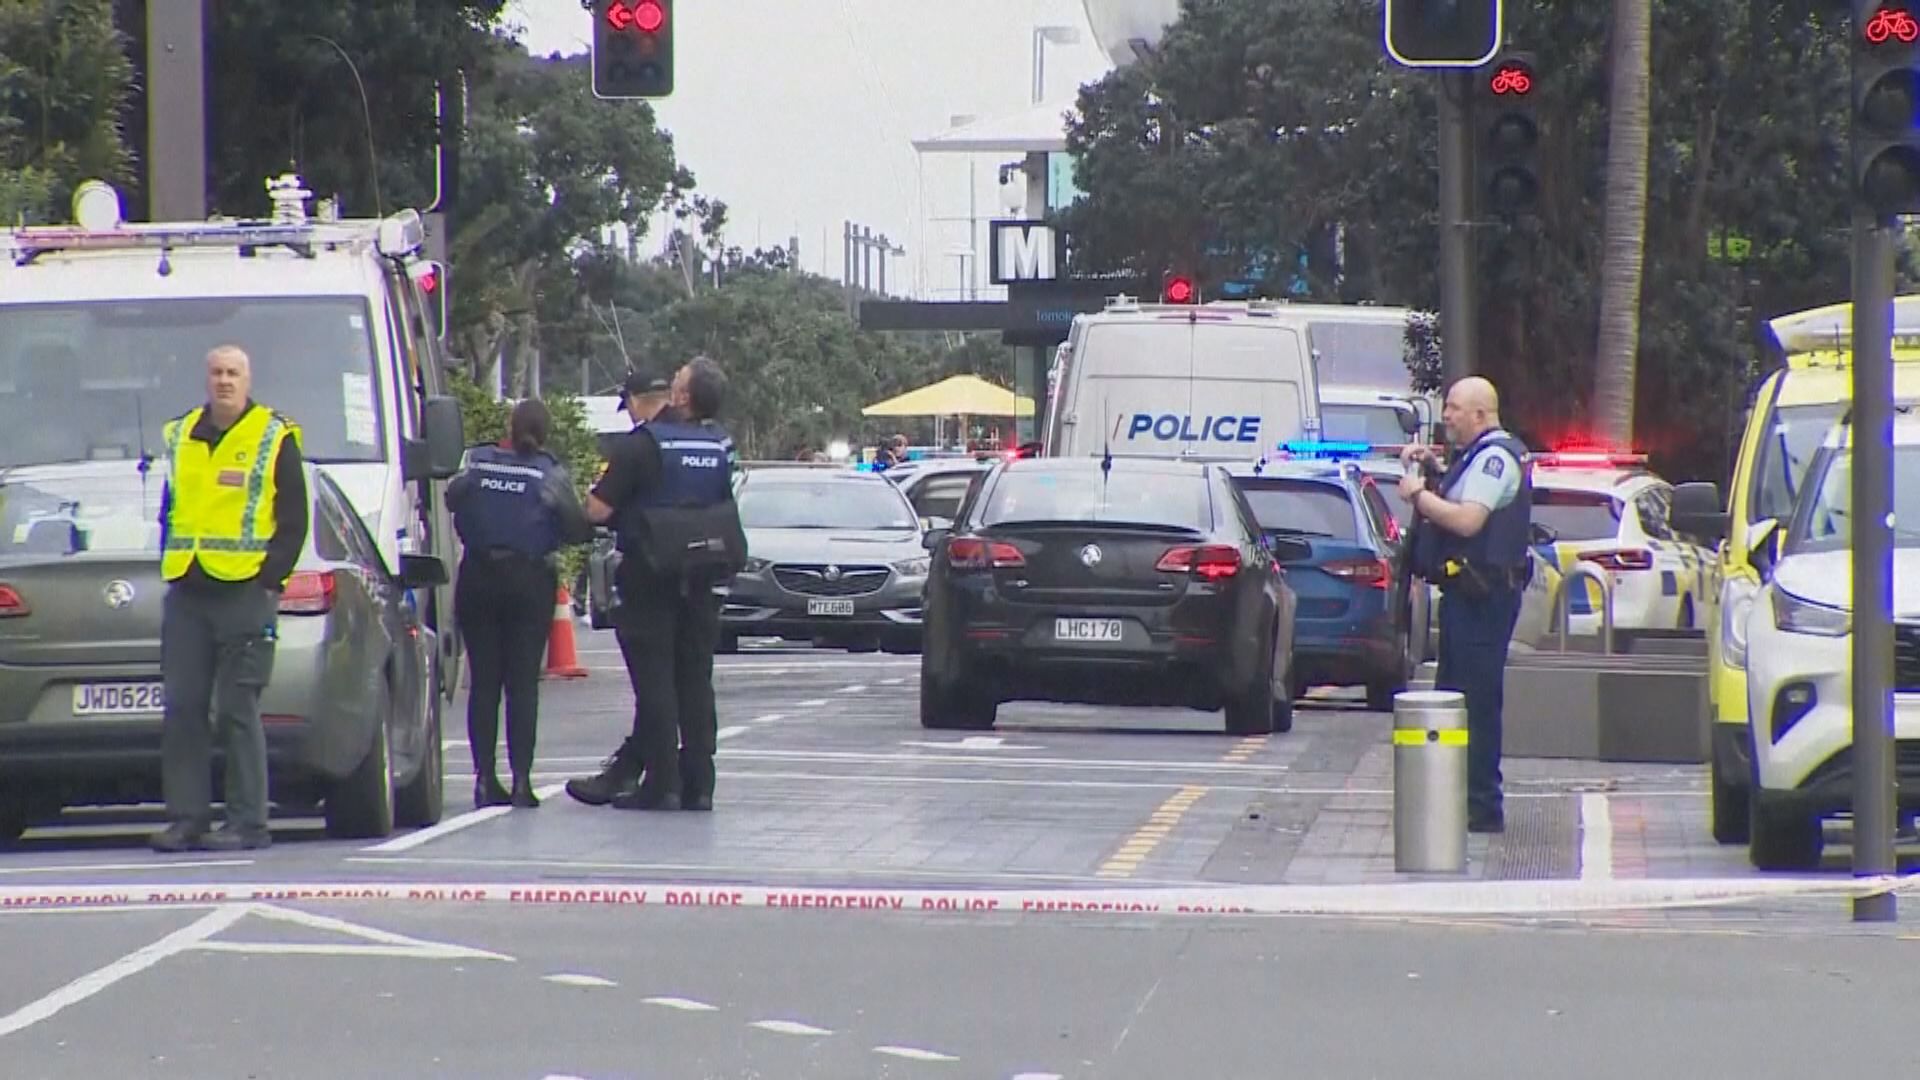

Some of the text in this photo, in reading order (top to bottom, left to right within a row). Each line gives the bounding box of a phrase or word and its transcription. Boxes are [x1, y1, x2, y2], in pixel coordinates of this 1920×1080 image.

[998, 225, 1056, 279] M
[1127, 414, 1261, 442] POLICE
[681, 455, 718, 467] POLICE
[480, 478, 526, 493] POLICE
[1058, 621, 1120, 637] LHC170
[77, 686, 163, 708] JWD628
